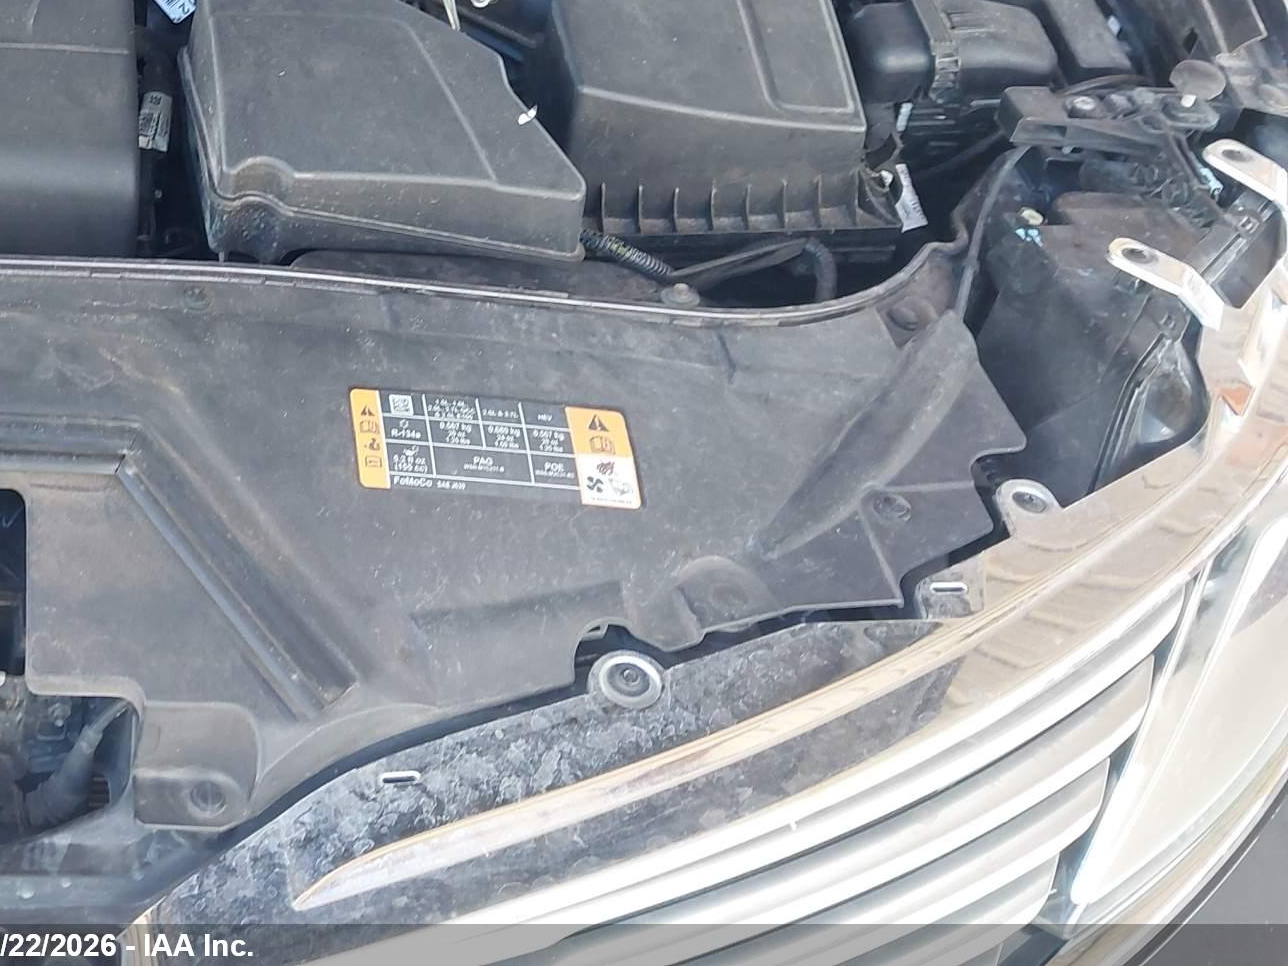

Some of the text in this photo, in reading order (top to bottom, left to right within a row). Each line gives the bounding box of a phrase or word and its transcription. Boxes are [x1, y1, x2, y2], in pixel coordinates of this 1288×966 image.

[391, 428, 422, 439] R-134a
[473, 455, 494, 465] PAG
[544, 461, 565, 472] POE
[393, 476, 433, 488] FoMoCo
